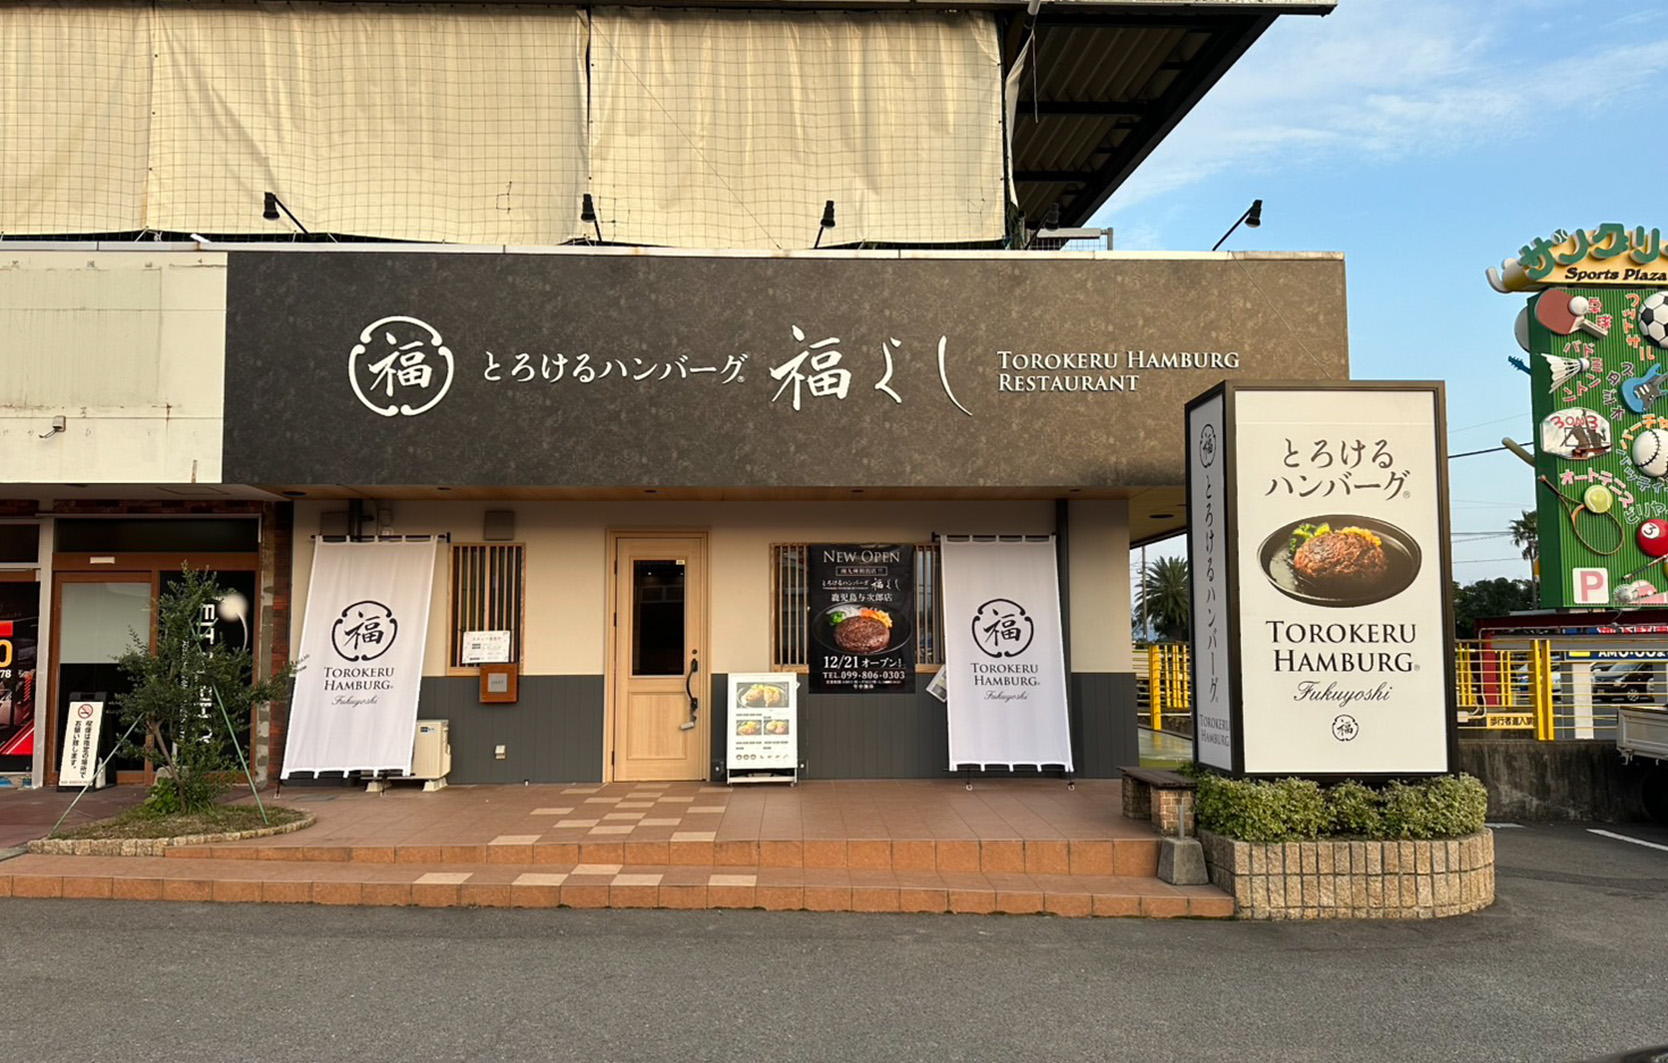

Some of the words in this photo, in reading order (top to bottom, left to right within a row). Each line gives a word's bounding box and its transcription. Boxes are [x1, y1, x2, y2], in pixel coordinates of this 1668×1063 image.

[1564, 267, 1619, 282] Sports
[1622, 268, 1668, 282] Plaza
[1622, 292, 1656, 362] フットサル
[368, 331, 433, 397] 福
[996, 350, 1119, 369] TOROKERU
[1126, 350, 1240, 369] HAMBURG
[997, 373, 1141, 392] RESTAURANT
[1283, 437, 1394, 469] とろける
[1559, 466, 1635, 509] オートテニス
[823, 550, 857, 563] NEW
[861, 549, 900, 563] OPEN
[1579, 570, 1604, 602] P
[343, 611, 385, 651] 福
[983, 608, 1022, 647] 福
[1265, 620, 1417, 644] TOROKERU
[324, 666, 395, 678] TOROKERU
[824, 655, 859, 669] 12/21
[970, 662, 1039, 674] TOROKERU
[1293, 680, 1393, 708] Fukuyoshi
[1200, 729, 1230, 747] HAMBURG
